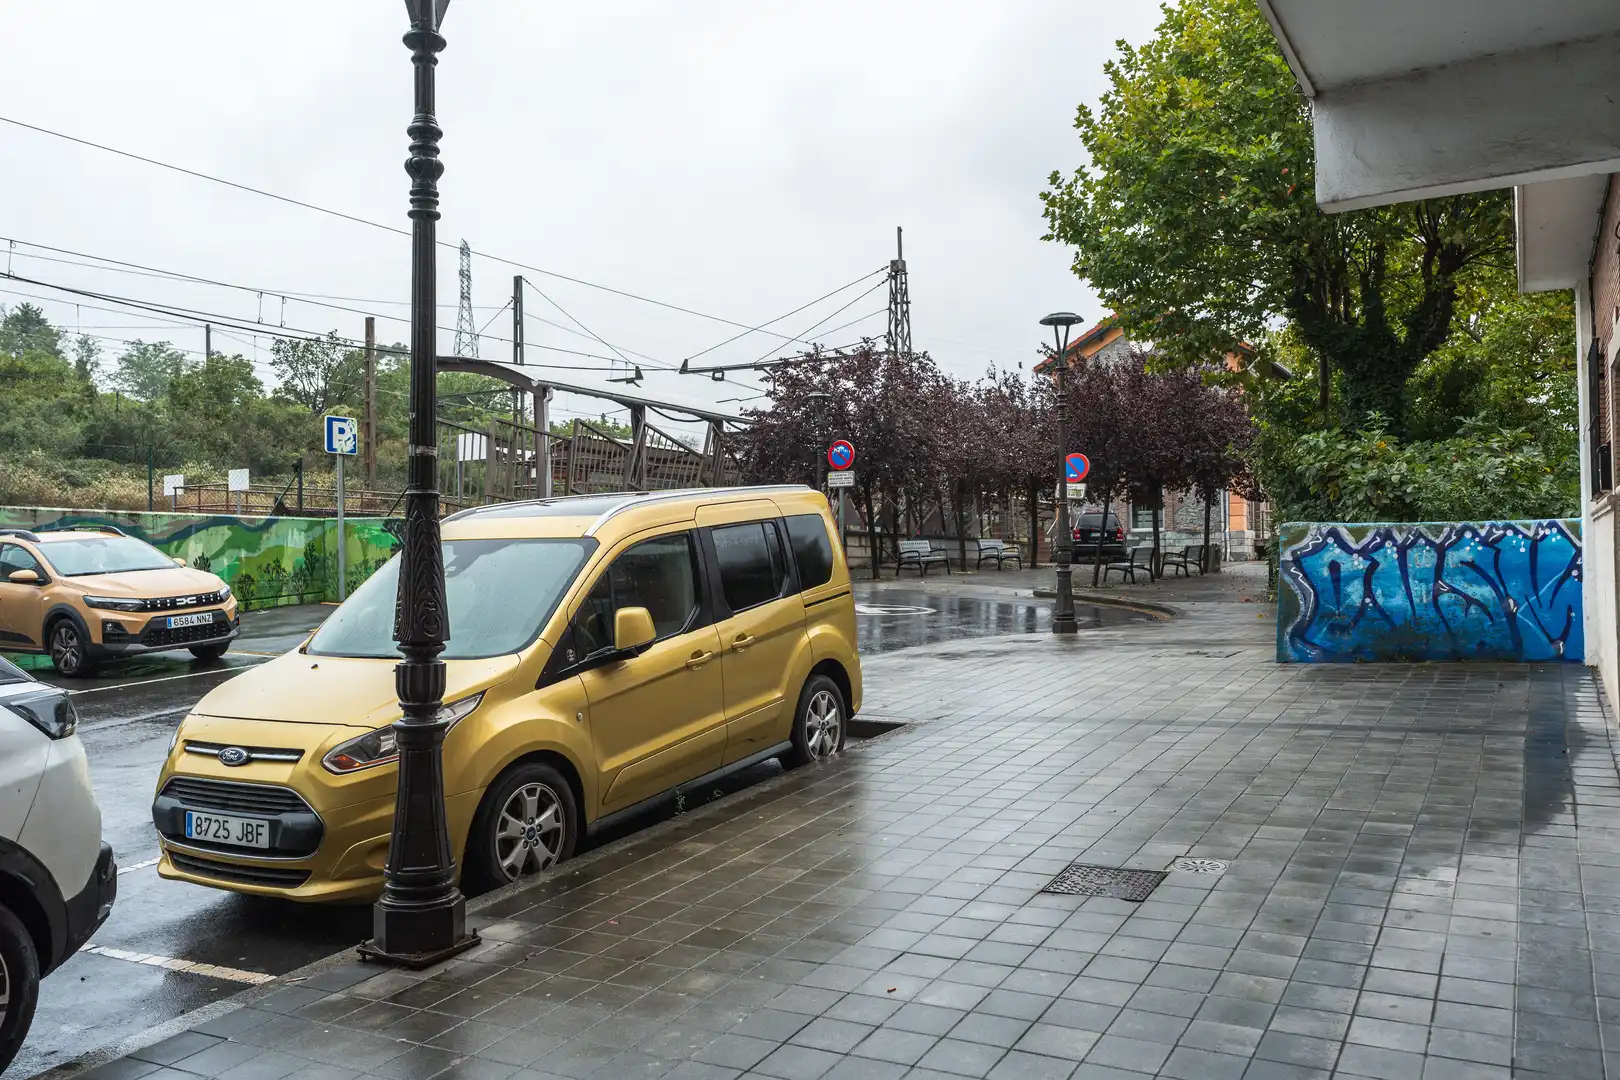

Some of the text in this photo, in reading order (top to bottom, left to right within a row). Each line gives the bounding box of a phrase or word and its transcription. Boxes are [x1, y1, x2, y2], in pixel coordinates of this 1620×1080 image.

[173, 614, 212, 626] 6584 NNZ
[222, 749, 239, 761] Ford
[195, 816, 264, 844] 8725 JBF
